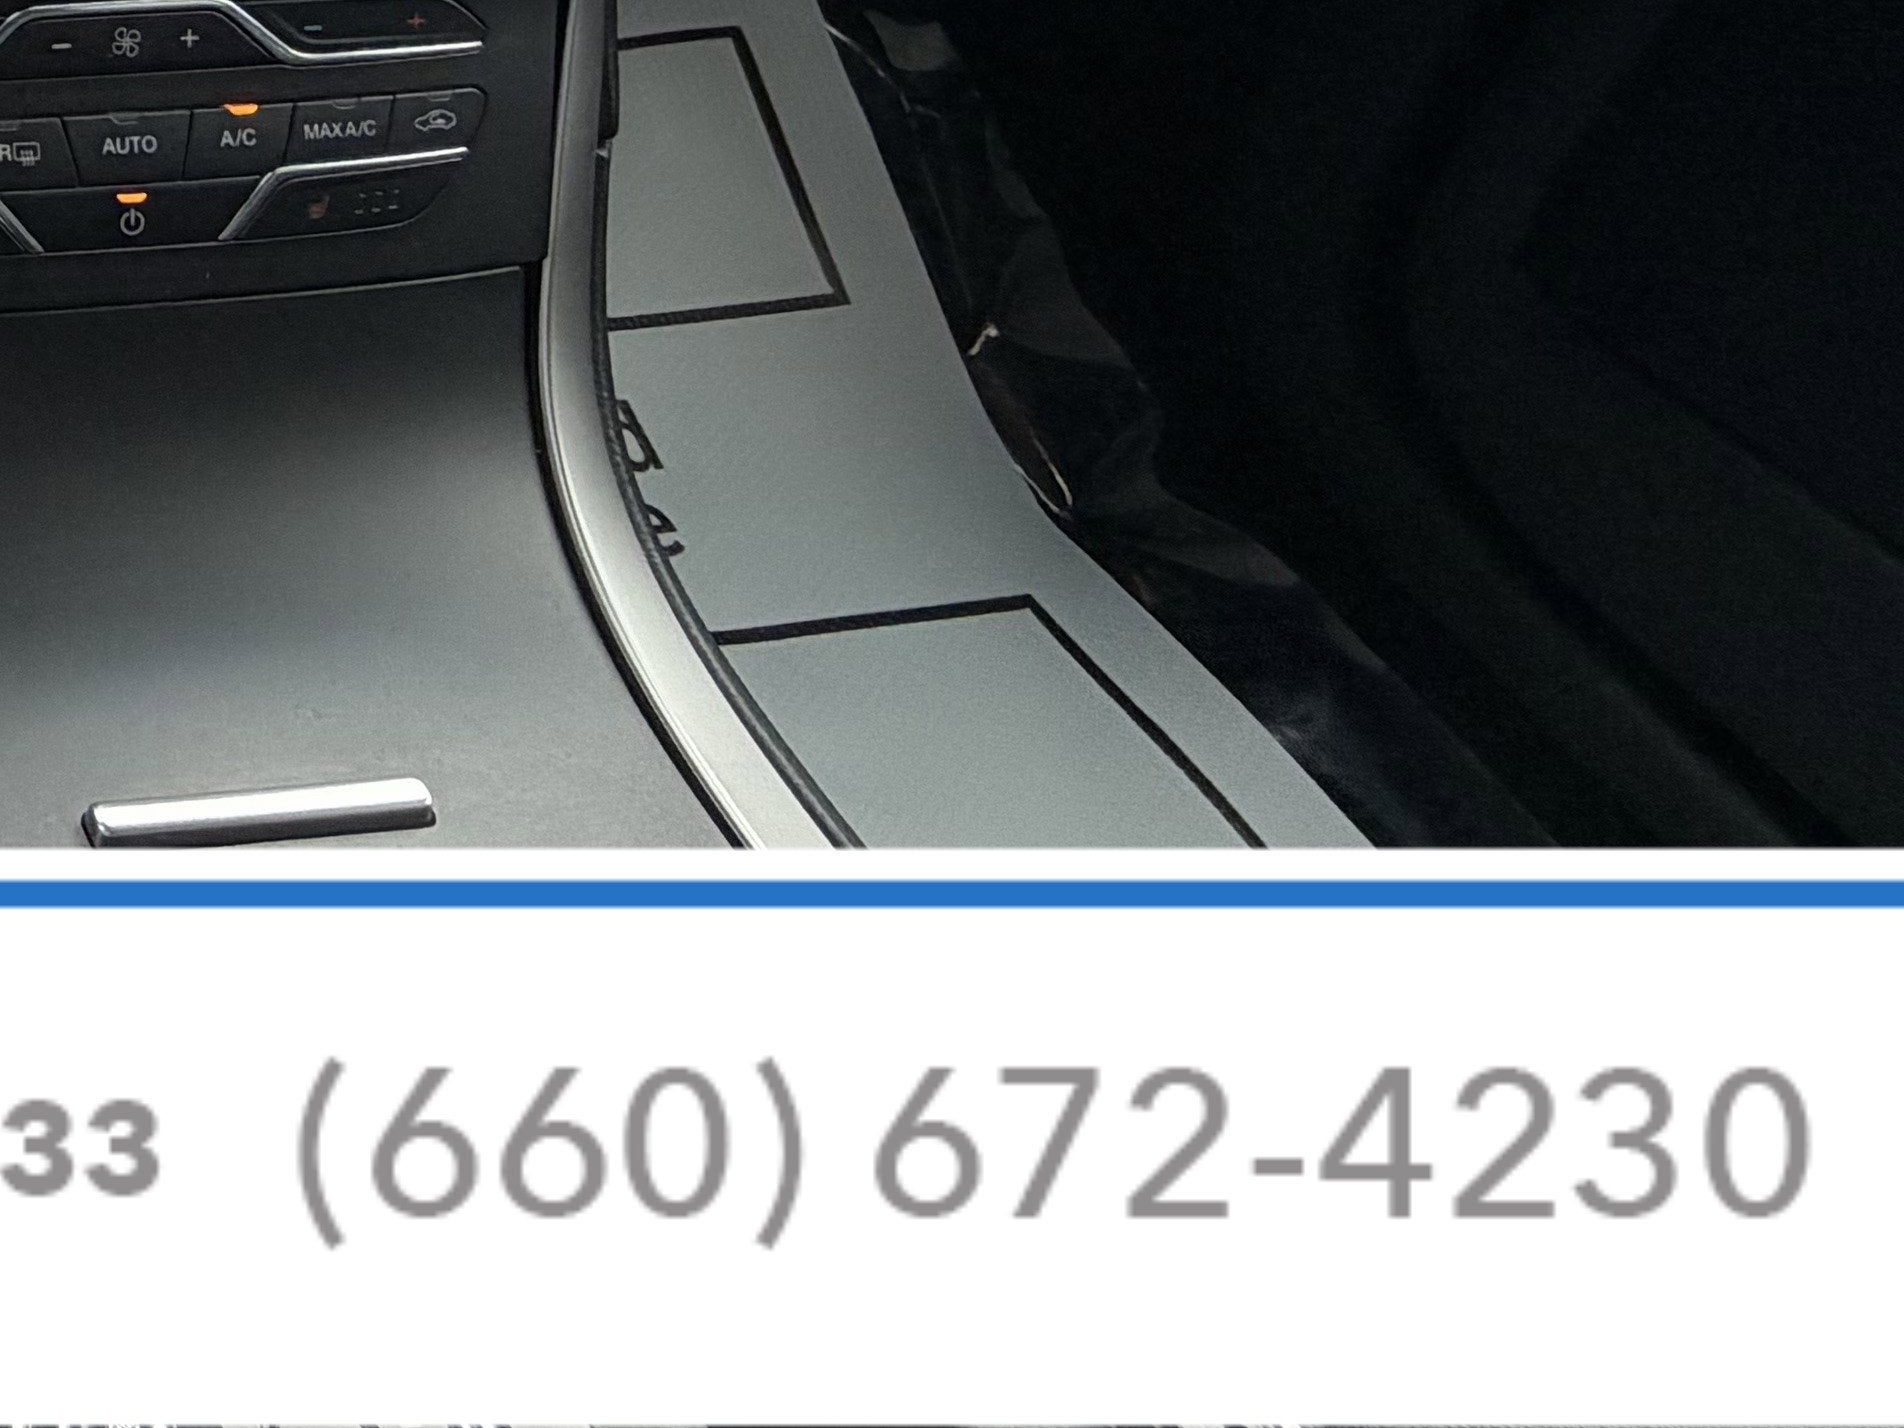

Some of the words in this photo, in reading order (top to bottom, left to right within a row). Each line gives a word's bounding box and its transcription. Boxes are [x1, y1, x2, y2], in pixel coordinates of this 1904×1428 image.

[219, 127, 258, 148] A/C
[303, 121, 345, 140] MAX
[345, 117, 377, 138] A/C
[101, 136, 159, 156] AUTO
